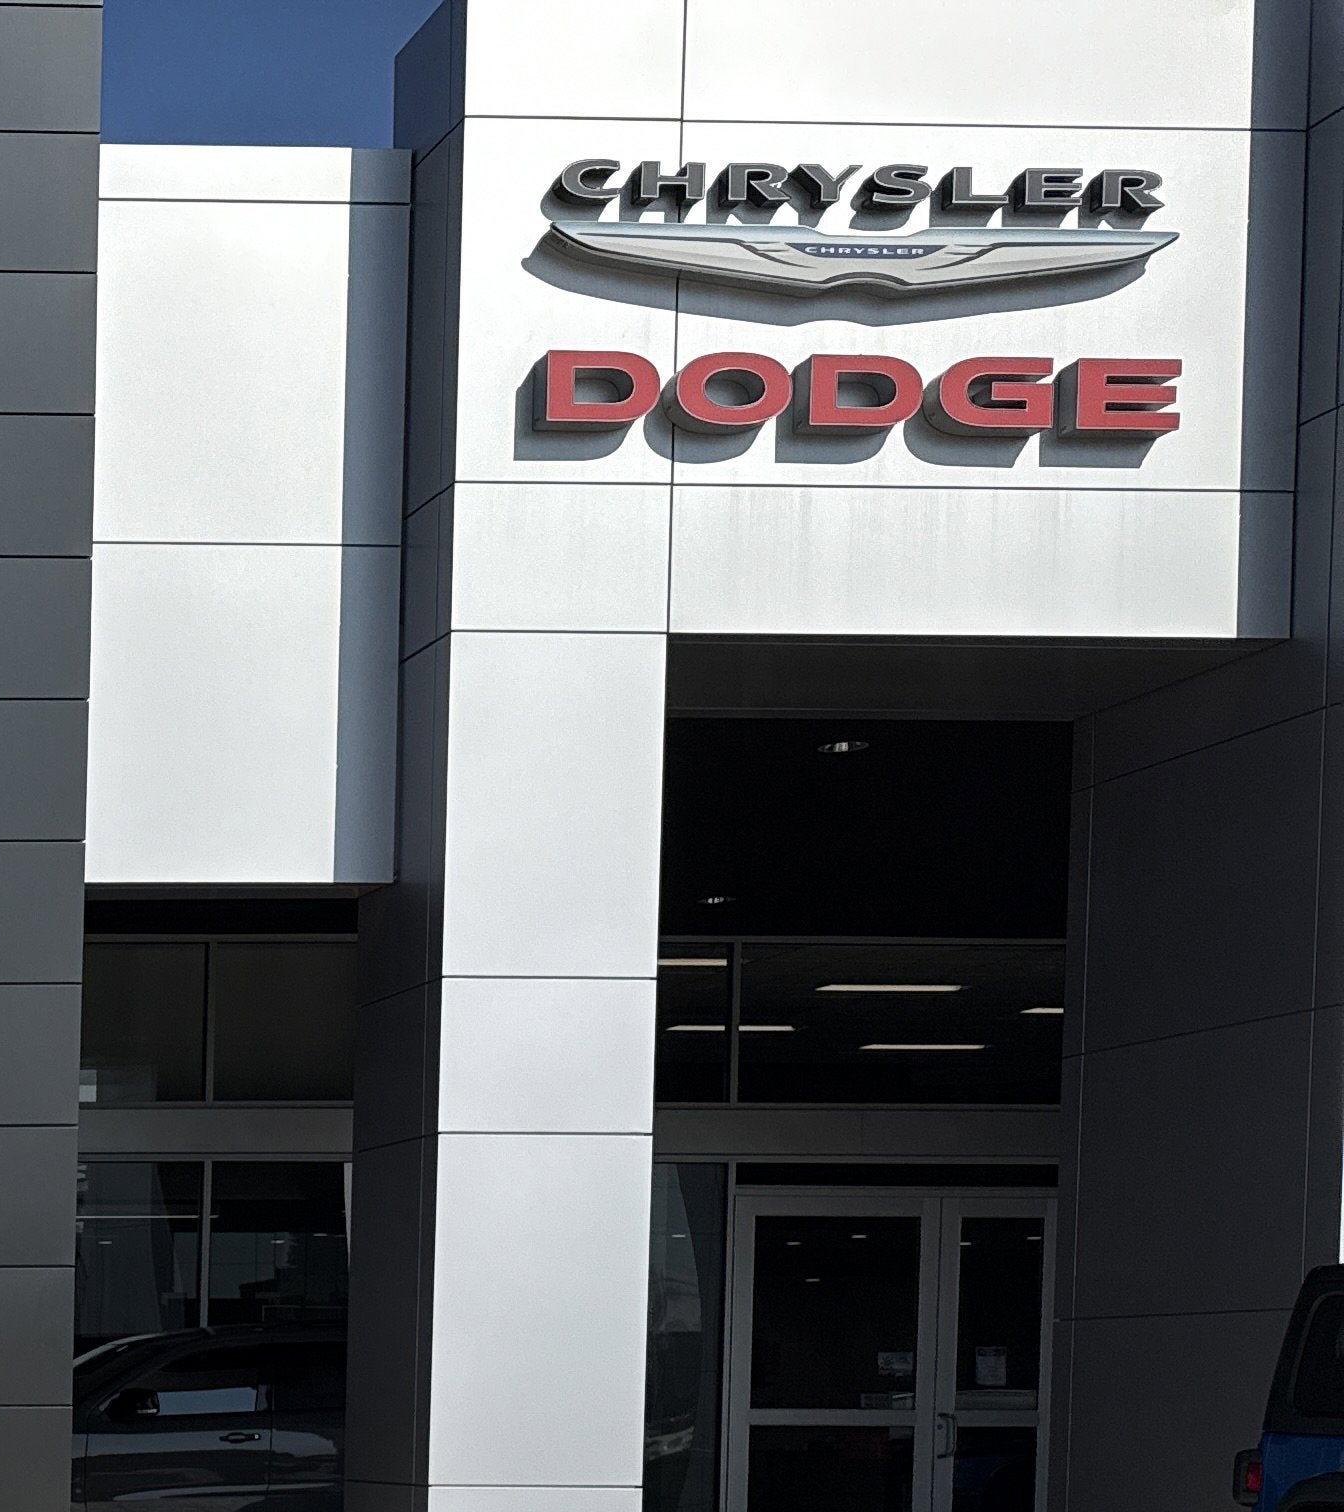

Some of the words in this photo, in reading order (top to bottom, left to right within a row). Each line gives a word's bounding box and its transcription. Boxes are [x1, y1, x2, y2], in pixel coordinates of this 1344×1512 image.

[552, 157, 1167, 210] CHRYSLER
[804, 245, 925, 256] CHRYSLER
[538, 349, 1183, 434] DODGE
